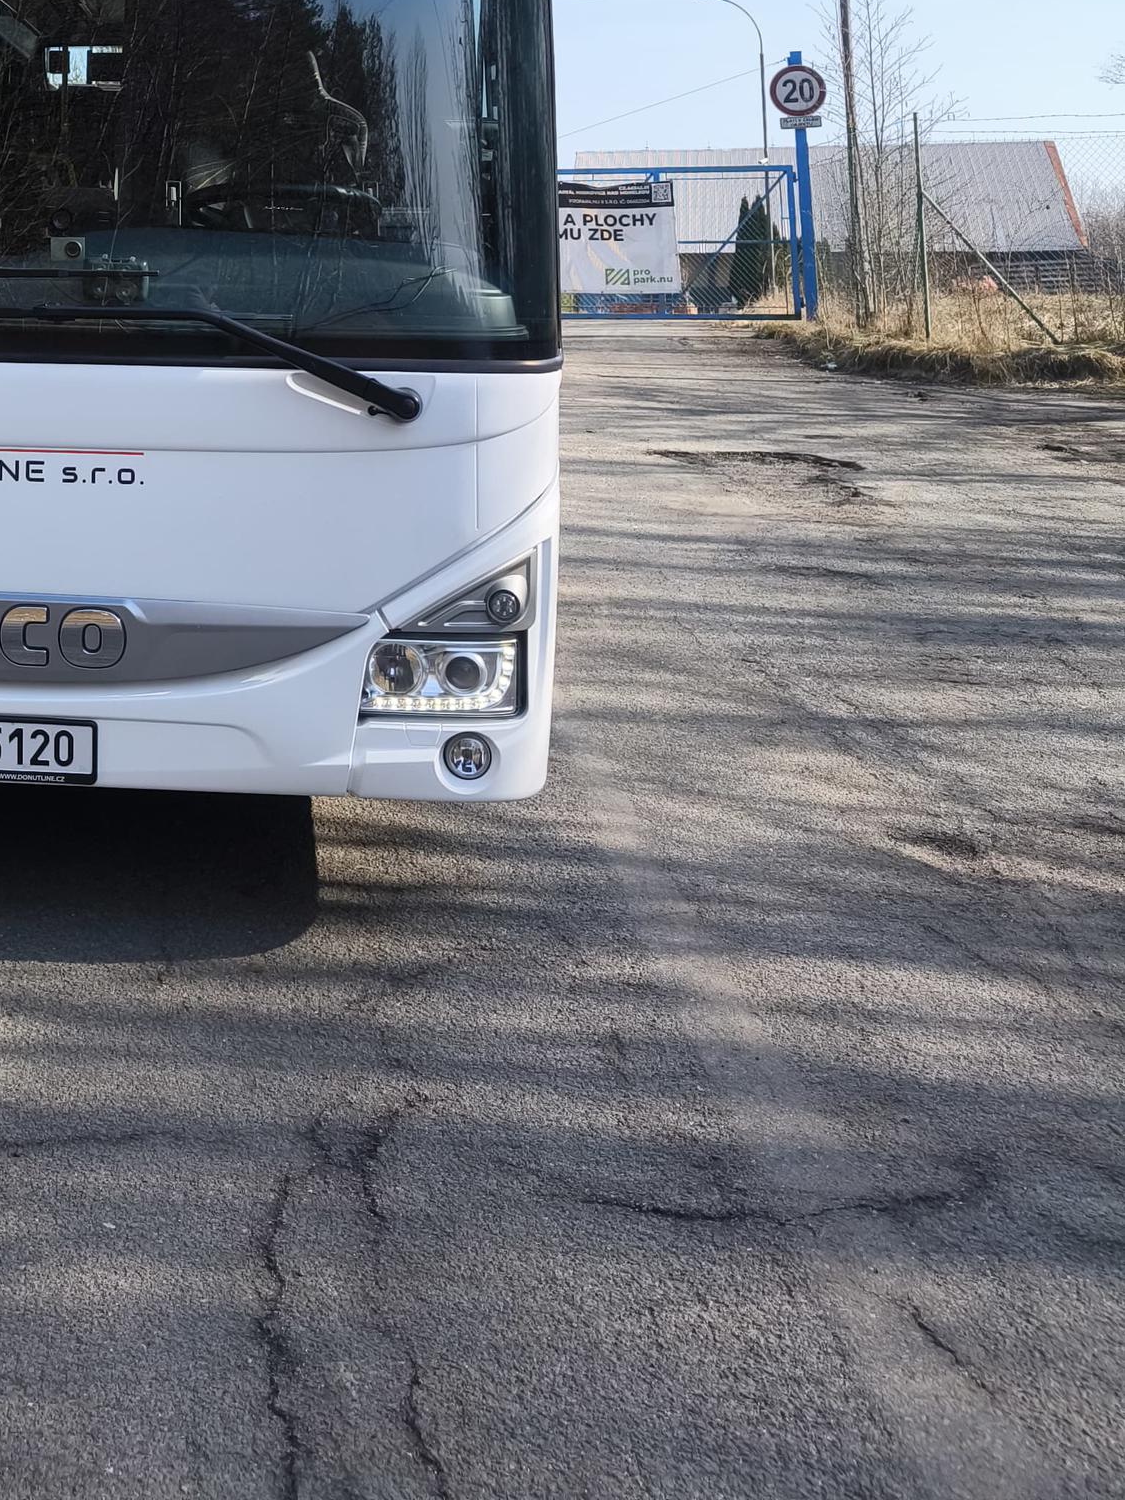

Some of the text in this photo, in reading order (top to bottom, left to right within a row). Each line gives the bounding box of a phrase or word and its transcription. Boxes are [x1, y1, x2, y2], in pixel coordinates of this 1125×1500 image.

[782, 78, 815, 103] 20
[563, 213, 657, 227] A PLOCHY
[588, 228, 624, 241] ZDE
[633, 269, 651, 277] pro
[633, 275, 673, 284] park.nu
[61, 466, 145, 485] s.r.o.
